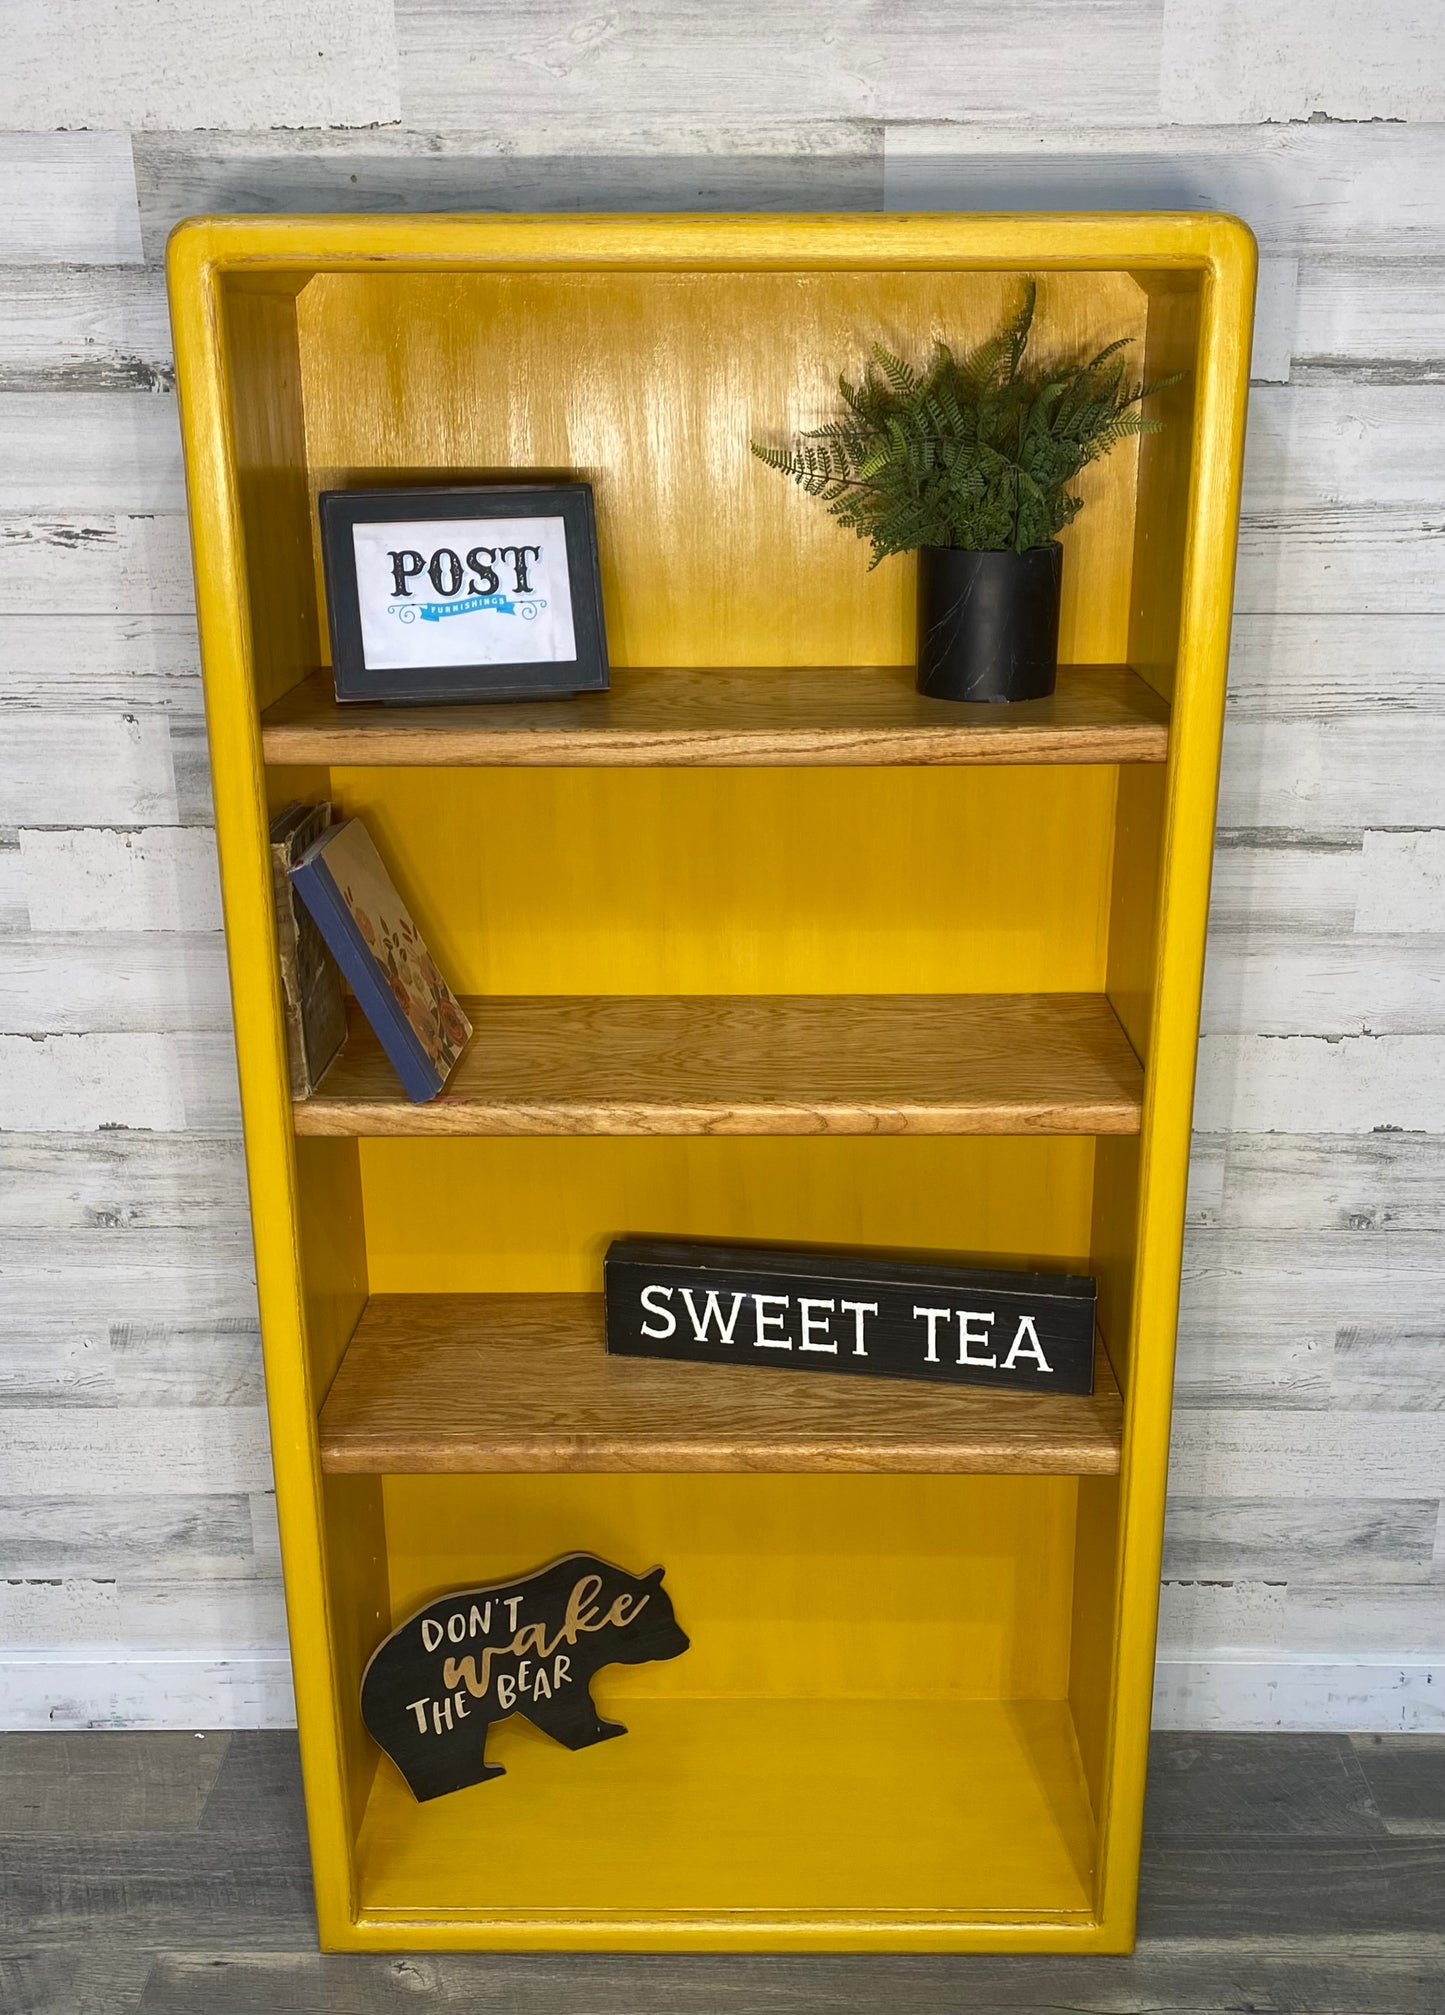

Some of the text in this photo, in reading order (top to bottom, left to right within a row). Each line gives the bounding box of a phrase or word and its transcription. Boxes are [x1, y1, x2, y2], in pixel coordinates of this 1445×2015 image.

[387, 545, 541, 597] POST
[431, 598, 505, 614] FURNISHINGS
[640, 1285, 1053, 1372] SWEET TEA
[421, 1596, 524, 1652] DON'T
[443, 1574, 650, 1698] wake
[406, 1655, 572, 1735] THE BEAR
